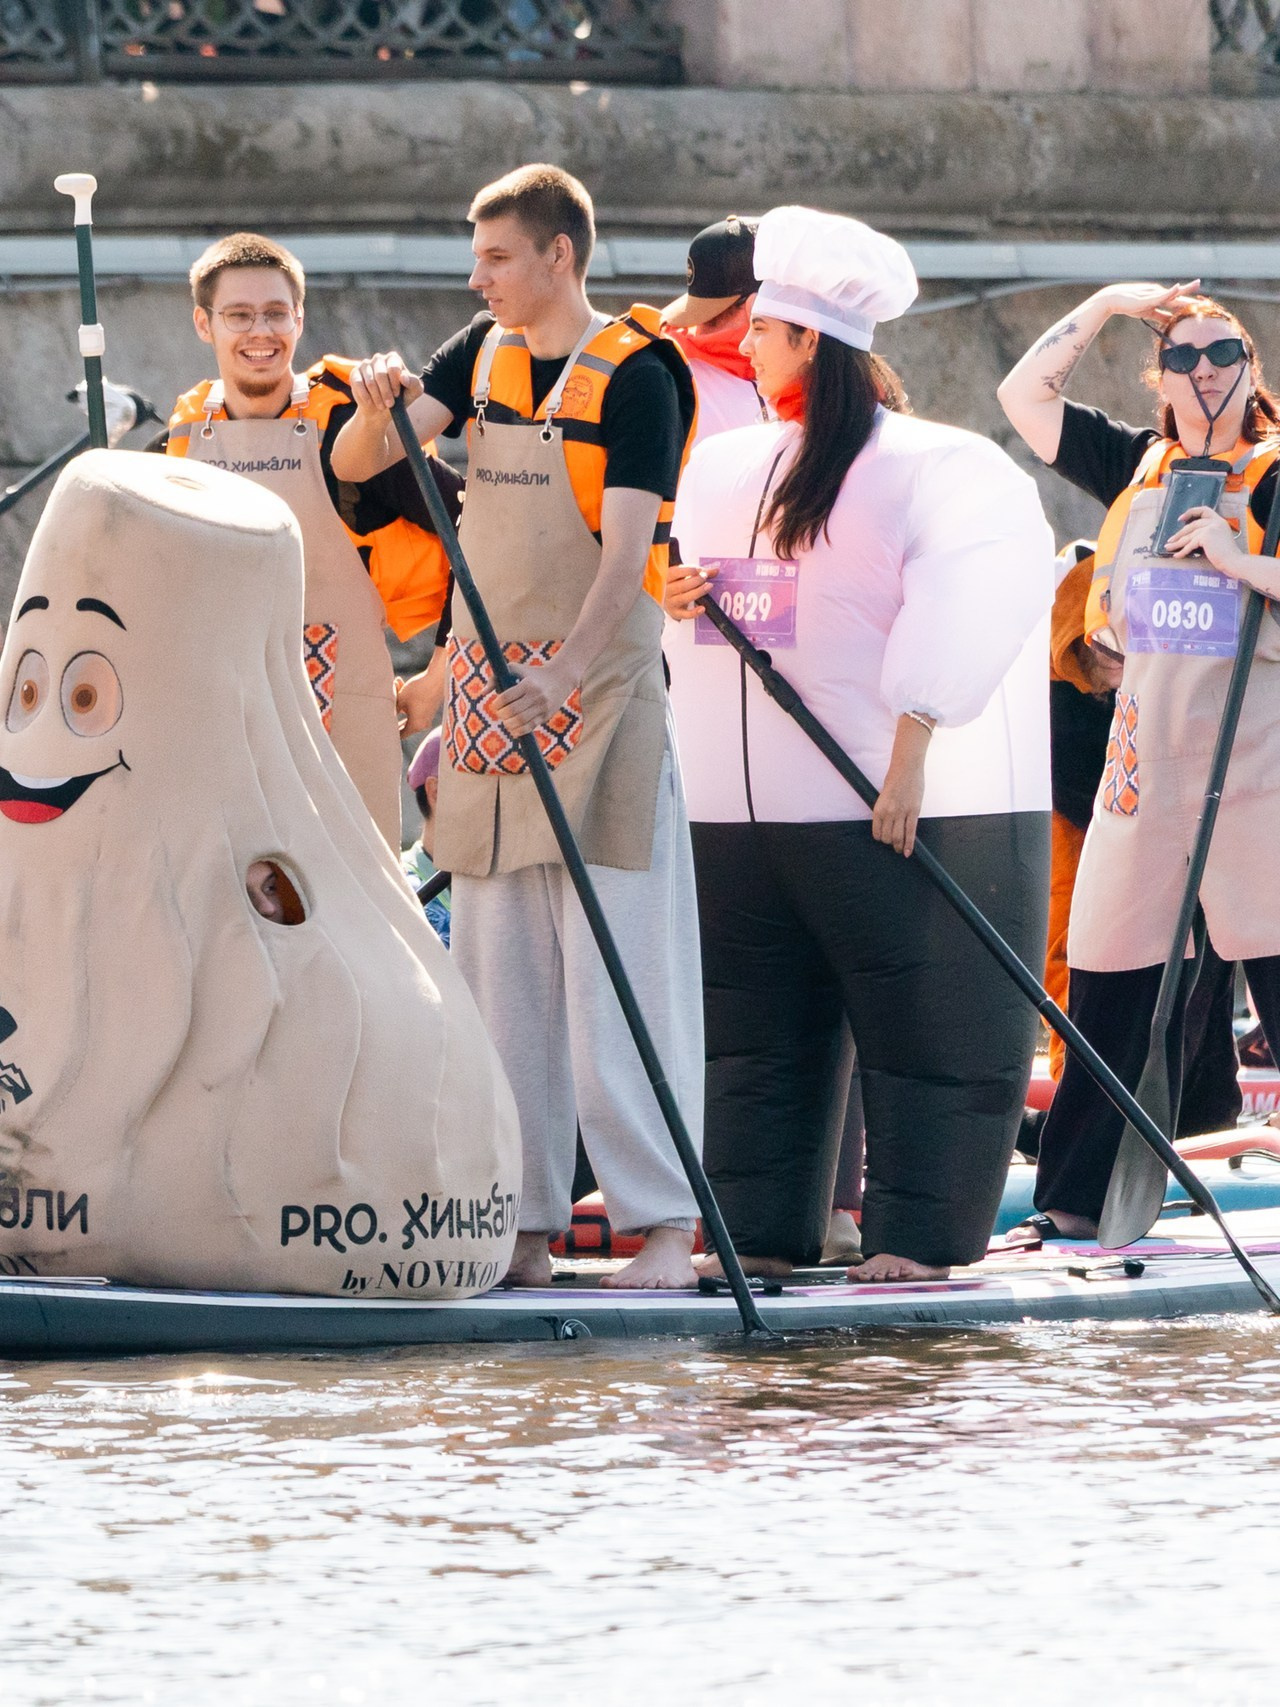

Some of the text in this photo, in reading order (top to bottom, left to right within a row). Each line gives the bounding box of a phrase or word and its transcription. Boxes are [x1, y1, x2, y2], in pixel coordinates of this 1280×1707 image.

[720, 591, 772, 622] 0829
[1152, 600, 1213, 631] 0830
[280, 1203, 388, 1254] PRO.
[341, 1269, 373, 1295] by
